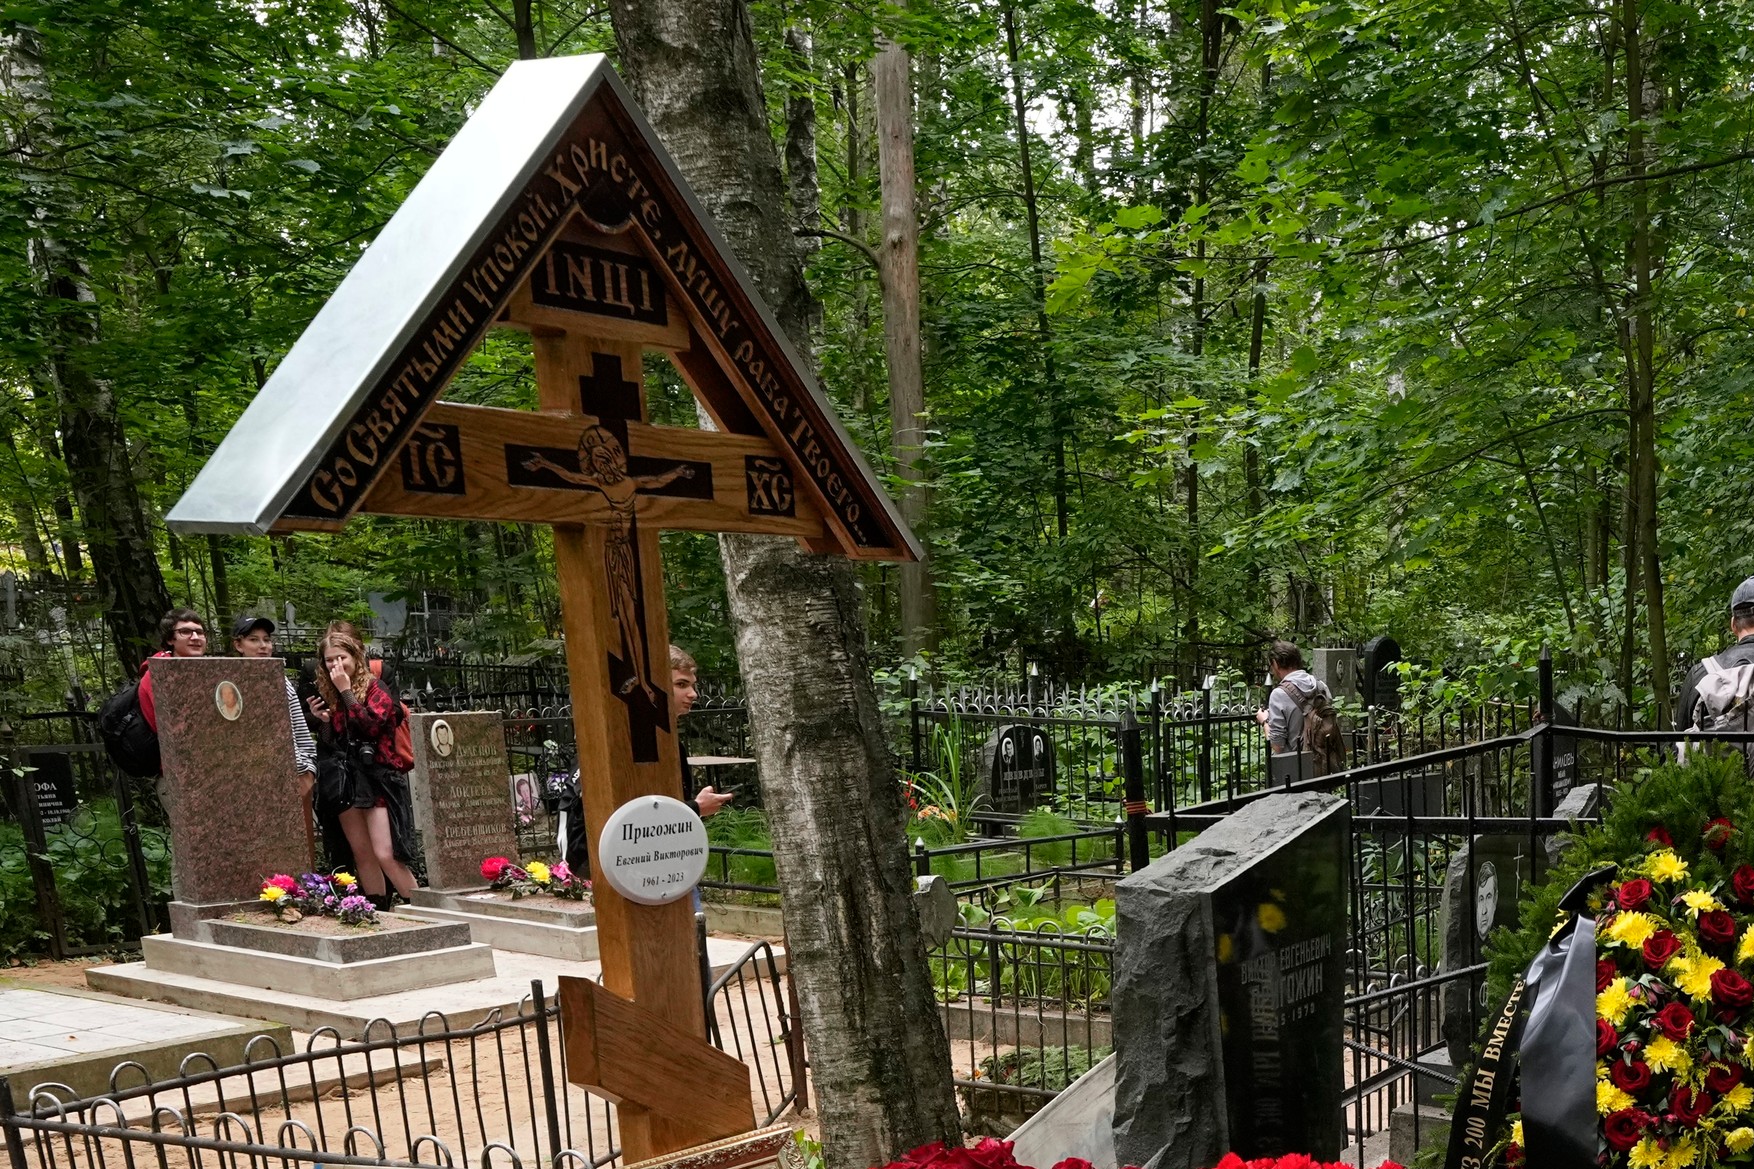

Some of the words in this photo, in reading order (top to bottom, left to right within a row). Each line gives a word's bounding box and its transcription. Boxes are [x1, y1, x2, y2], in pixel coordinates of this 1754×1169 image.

[621, 820, 694, 844] Пригожин
[615, 851, 652, 868] Евгений
[653, 847, 704, 864] Викторович
[641, 875, 660, 888] 1961
[667, 872, 685, 884] 2023
[1482, 979, 1527, 1063] ВМЕСТЕ
[1470, 1067, 1496, 1111] МЫ
[1464, 1116, 1486, 1150] 200
